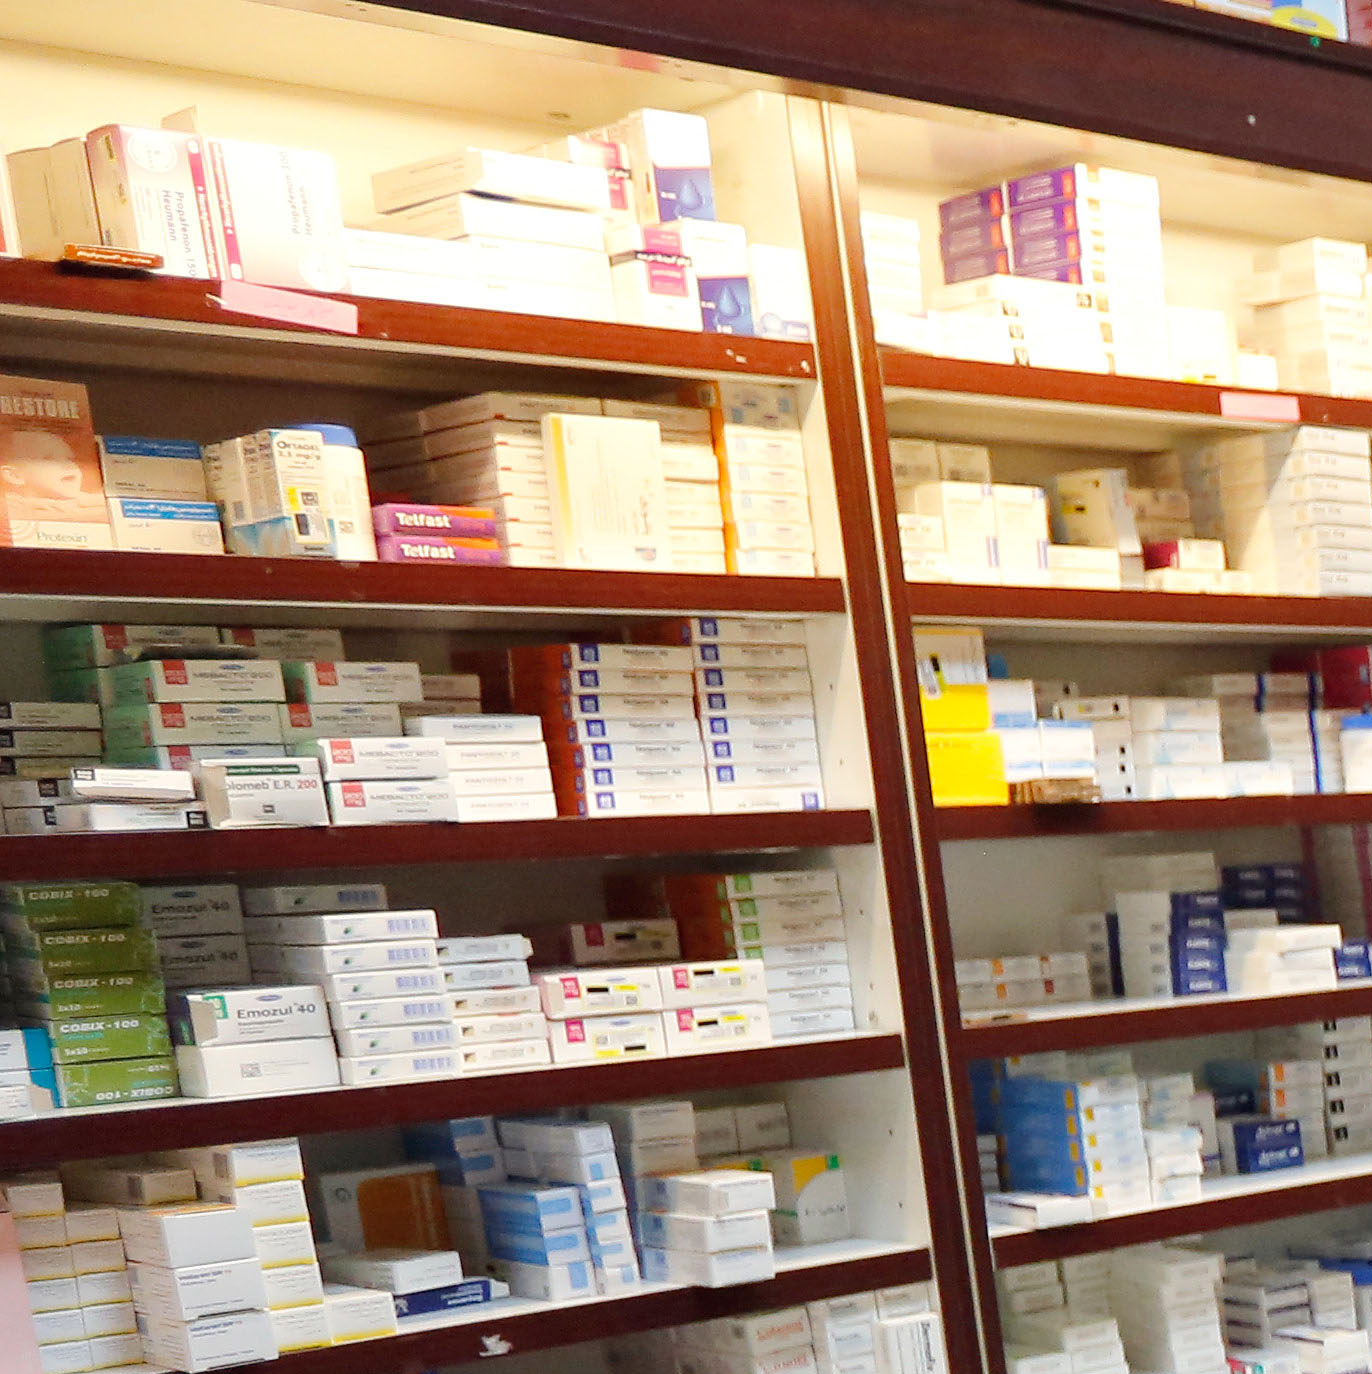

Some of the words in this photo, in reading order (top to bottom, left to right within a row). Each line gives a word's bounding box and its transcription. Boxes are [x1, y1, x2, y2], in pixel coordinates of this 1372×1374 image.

[163, 190, 177, 241] Heumann
[175, 191, 193, 253] Propafenon
[186, 257, 197, 277] 150
[395, 512, 452, 528] Telfast
[400, 543, 456, 560] Telfast
[297, 780, 318, 790] 200
[152, 900, 207, 915] Emozul
[210, 899, 230, 913] 40
[161, 950, 216, 966] Emozul
[219, 949, 239, 962] 40
[237, 1004, 294, 1020] Emozul
[296, 1002, 316, 1015] 40
[59, 1021, 105, 1033] COBIX
[114, 1019, 140, 1029] 100
